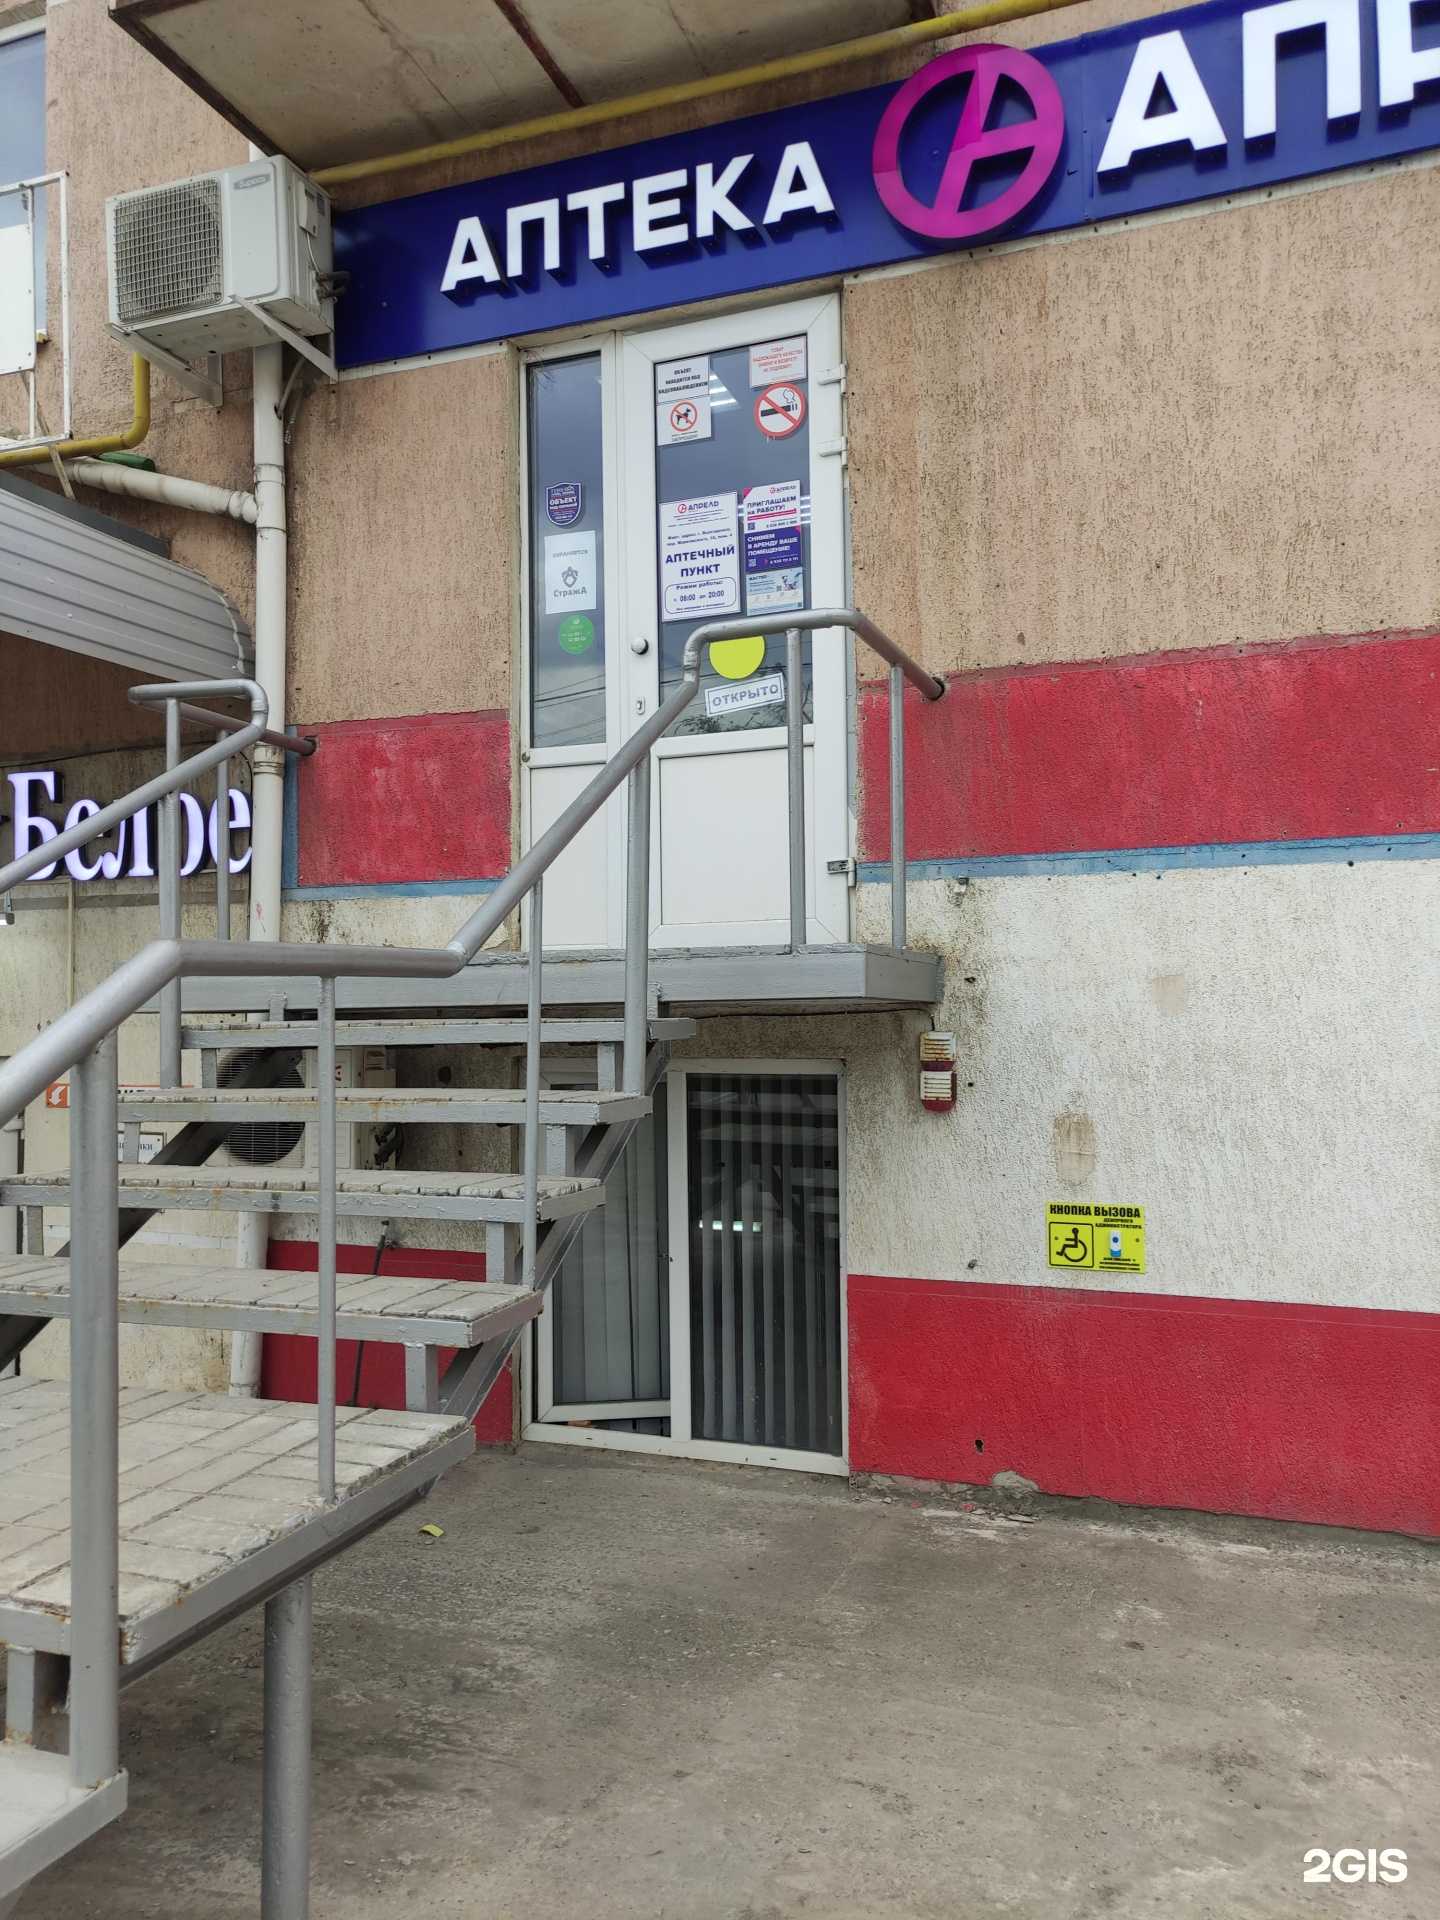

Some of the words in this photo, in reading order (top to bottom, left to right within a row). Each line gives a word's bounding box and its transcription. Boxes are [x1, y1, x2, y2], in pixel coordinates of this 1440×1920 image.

[440, 141, 836, 292] АПТЕКА
[549, 496, 577, 506] ОБЪЕКТ
[688, 501, 719, 512] АПРЕЛЬ
[748, 496, 797, 508] ПРИГЛАШАЕМ
[665, 545, 735, 564] АПТЕЧНЫЙ
[680, 564, 721, 577] ПУНКТ
[708, 590, 725, 598] 20:00
[712, 684, 779, 706] ОТКРЫТО
[1049, 1204, 1092, 1216] КНОПКА
[1094, 1206, 1141, 1218] ВЫЗОВА
